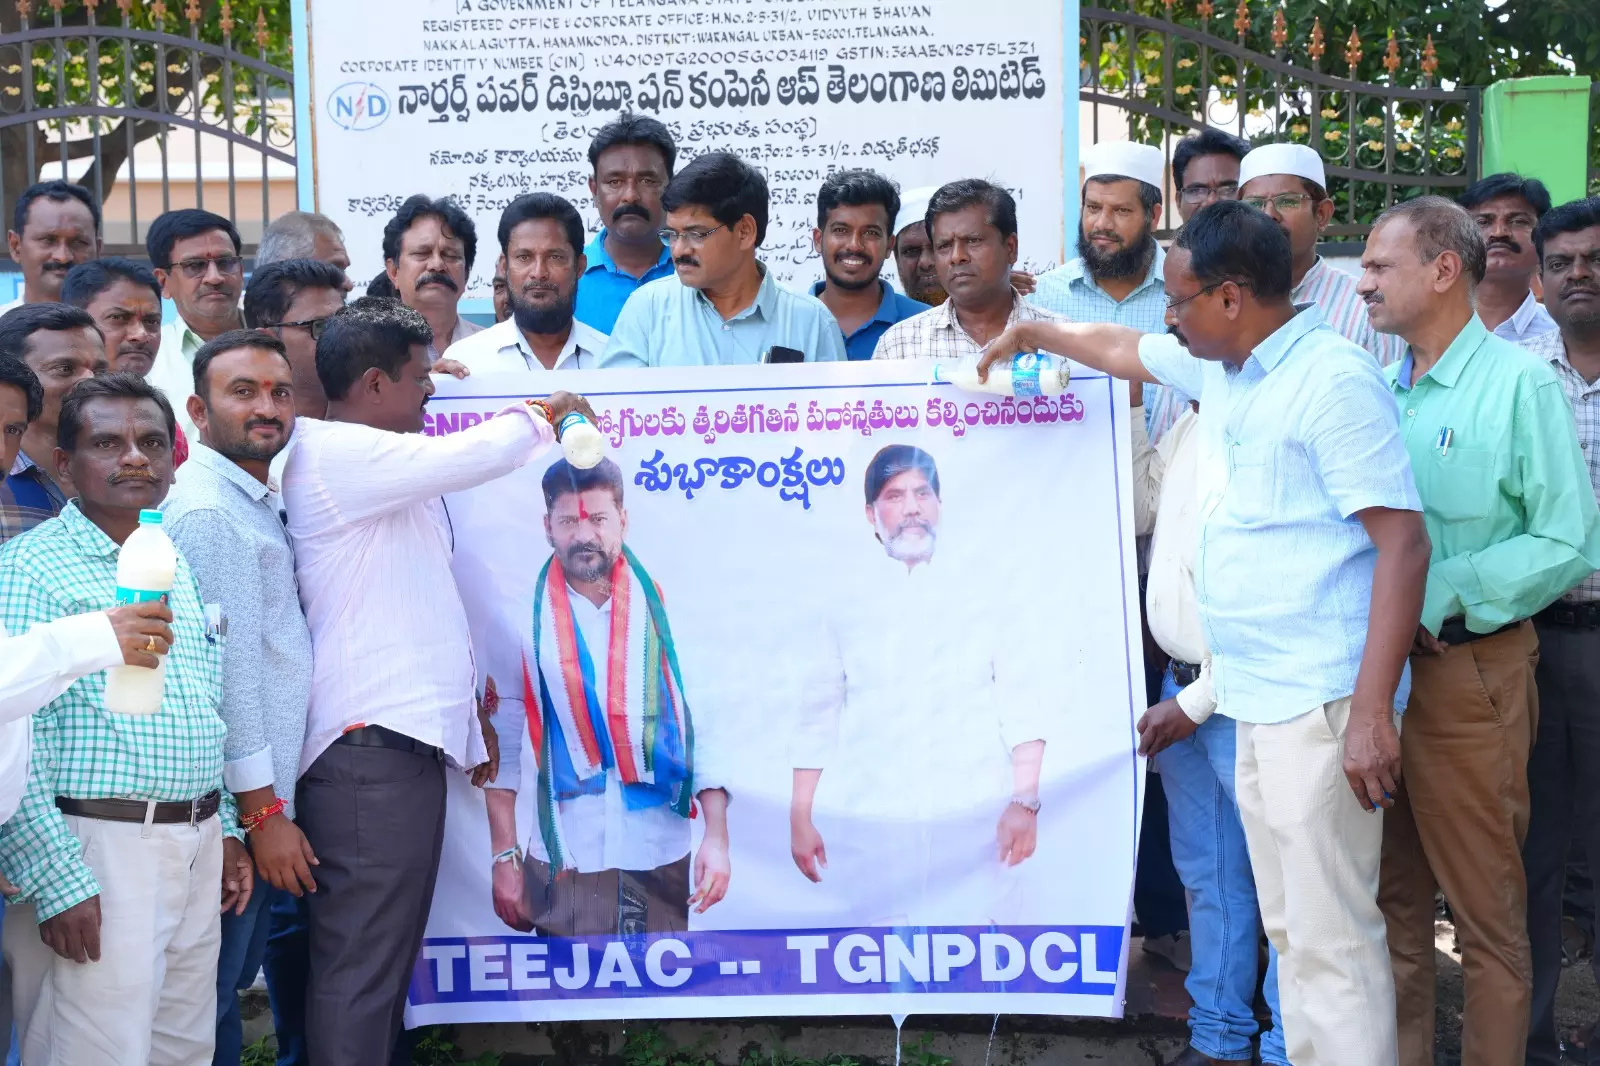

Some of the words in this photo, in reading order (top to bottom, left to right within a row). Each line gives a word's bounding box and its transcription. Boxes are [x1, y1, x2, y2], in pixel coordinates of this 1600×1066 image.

[422, 18, 504, 32] REGISTERED
[509, 17, 560, 30] OFFICE
[573, 13, 653, 28] CORPORATE
[424, 58, 489, 72] IDENTITY
[493, 55, 545, 70] NUMBER
[476, 72, 539, 114] పవర్
[826, 64, 947, 104] తెలంగాణ
[692, 402, 800, 444] త్వరితగతిన
[806, 400, 919, 436] పదోన్నతులు
[926, 393, 1085, 437] కల్పించినందుకు
[634, 446, 846, 510] శుభాకాంక్షలు
[423, 938, 694, 993] TEEJAC
[786, 931, 1117, 985] TGNPDCL
